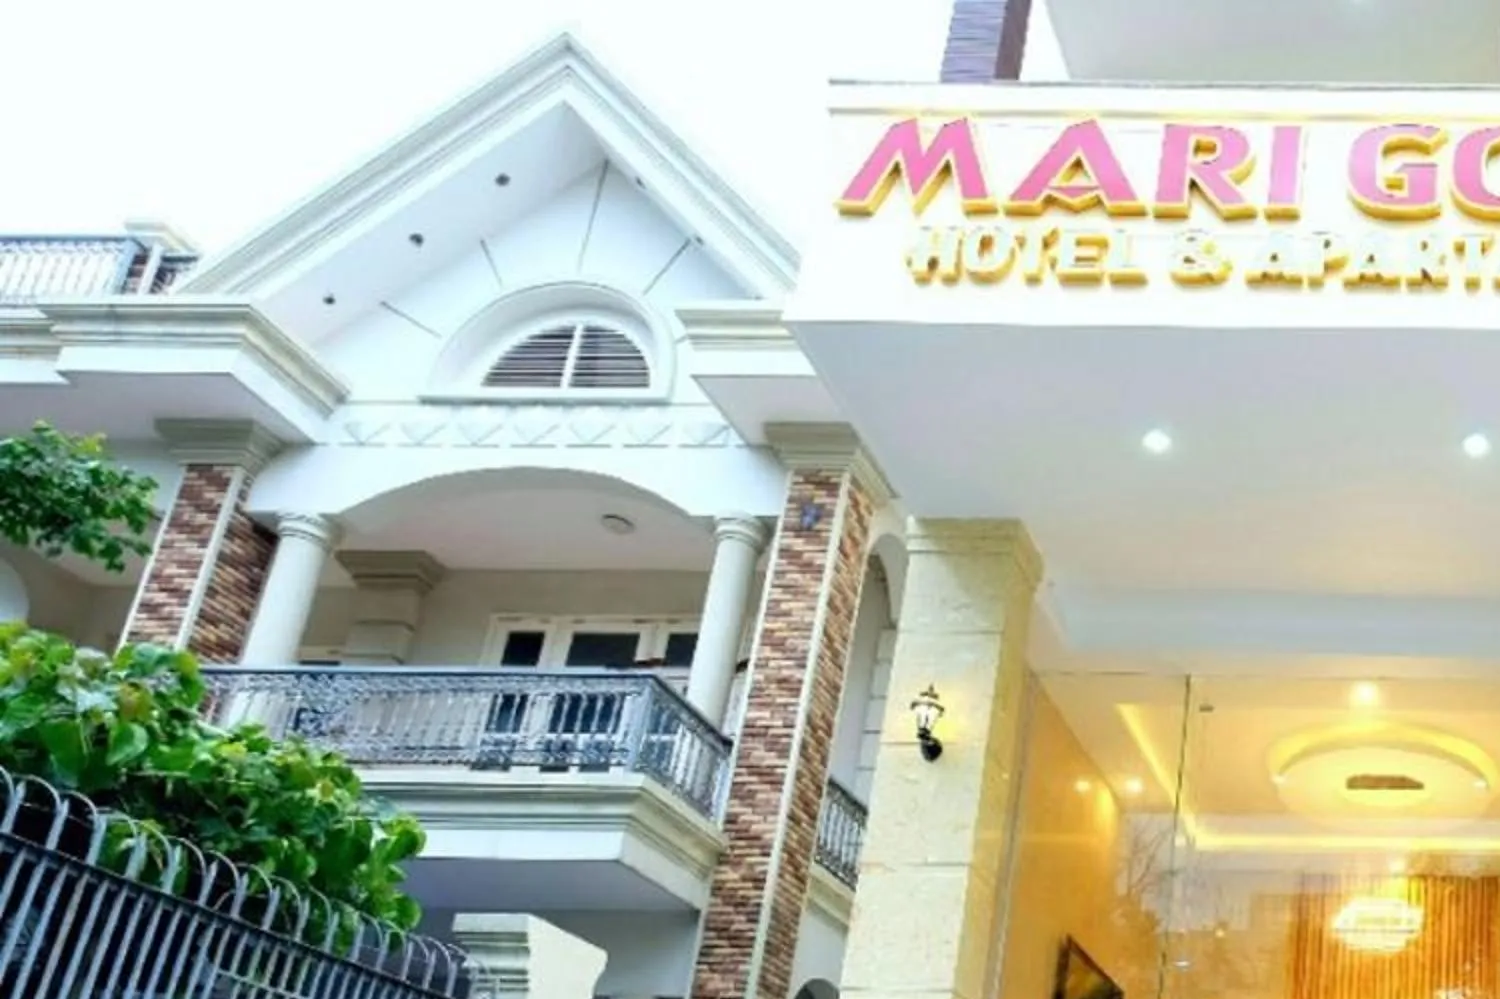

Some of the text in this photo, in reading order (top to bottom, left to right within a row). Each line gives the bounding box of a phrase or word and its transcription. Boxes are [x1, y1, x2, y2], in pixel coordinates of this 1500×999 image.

[836, 118, 1302, 220] MARI
[906, 226, 1149, 286] HOTEL
[1170, 229, 1232, 287] &
